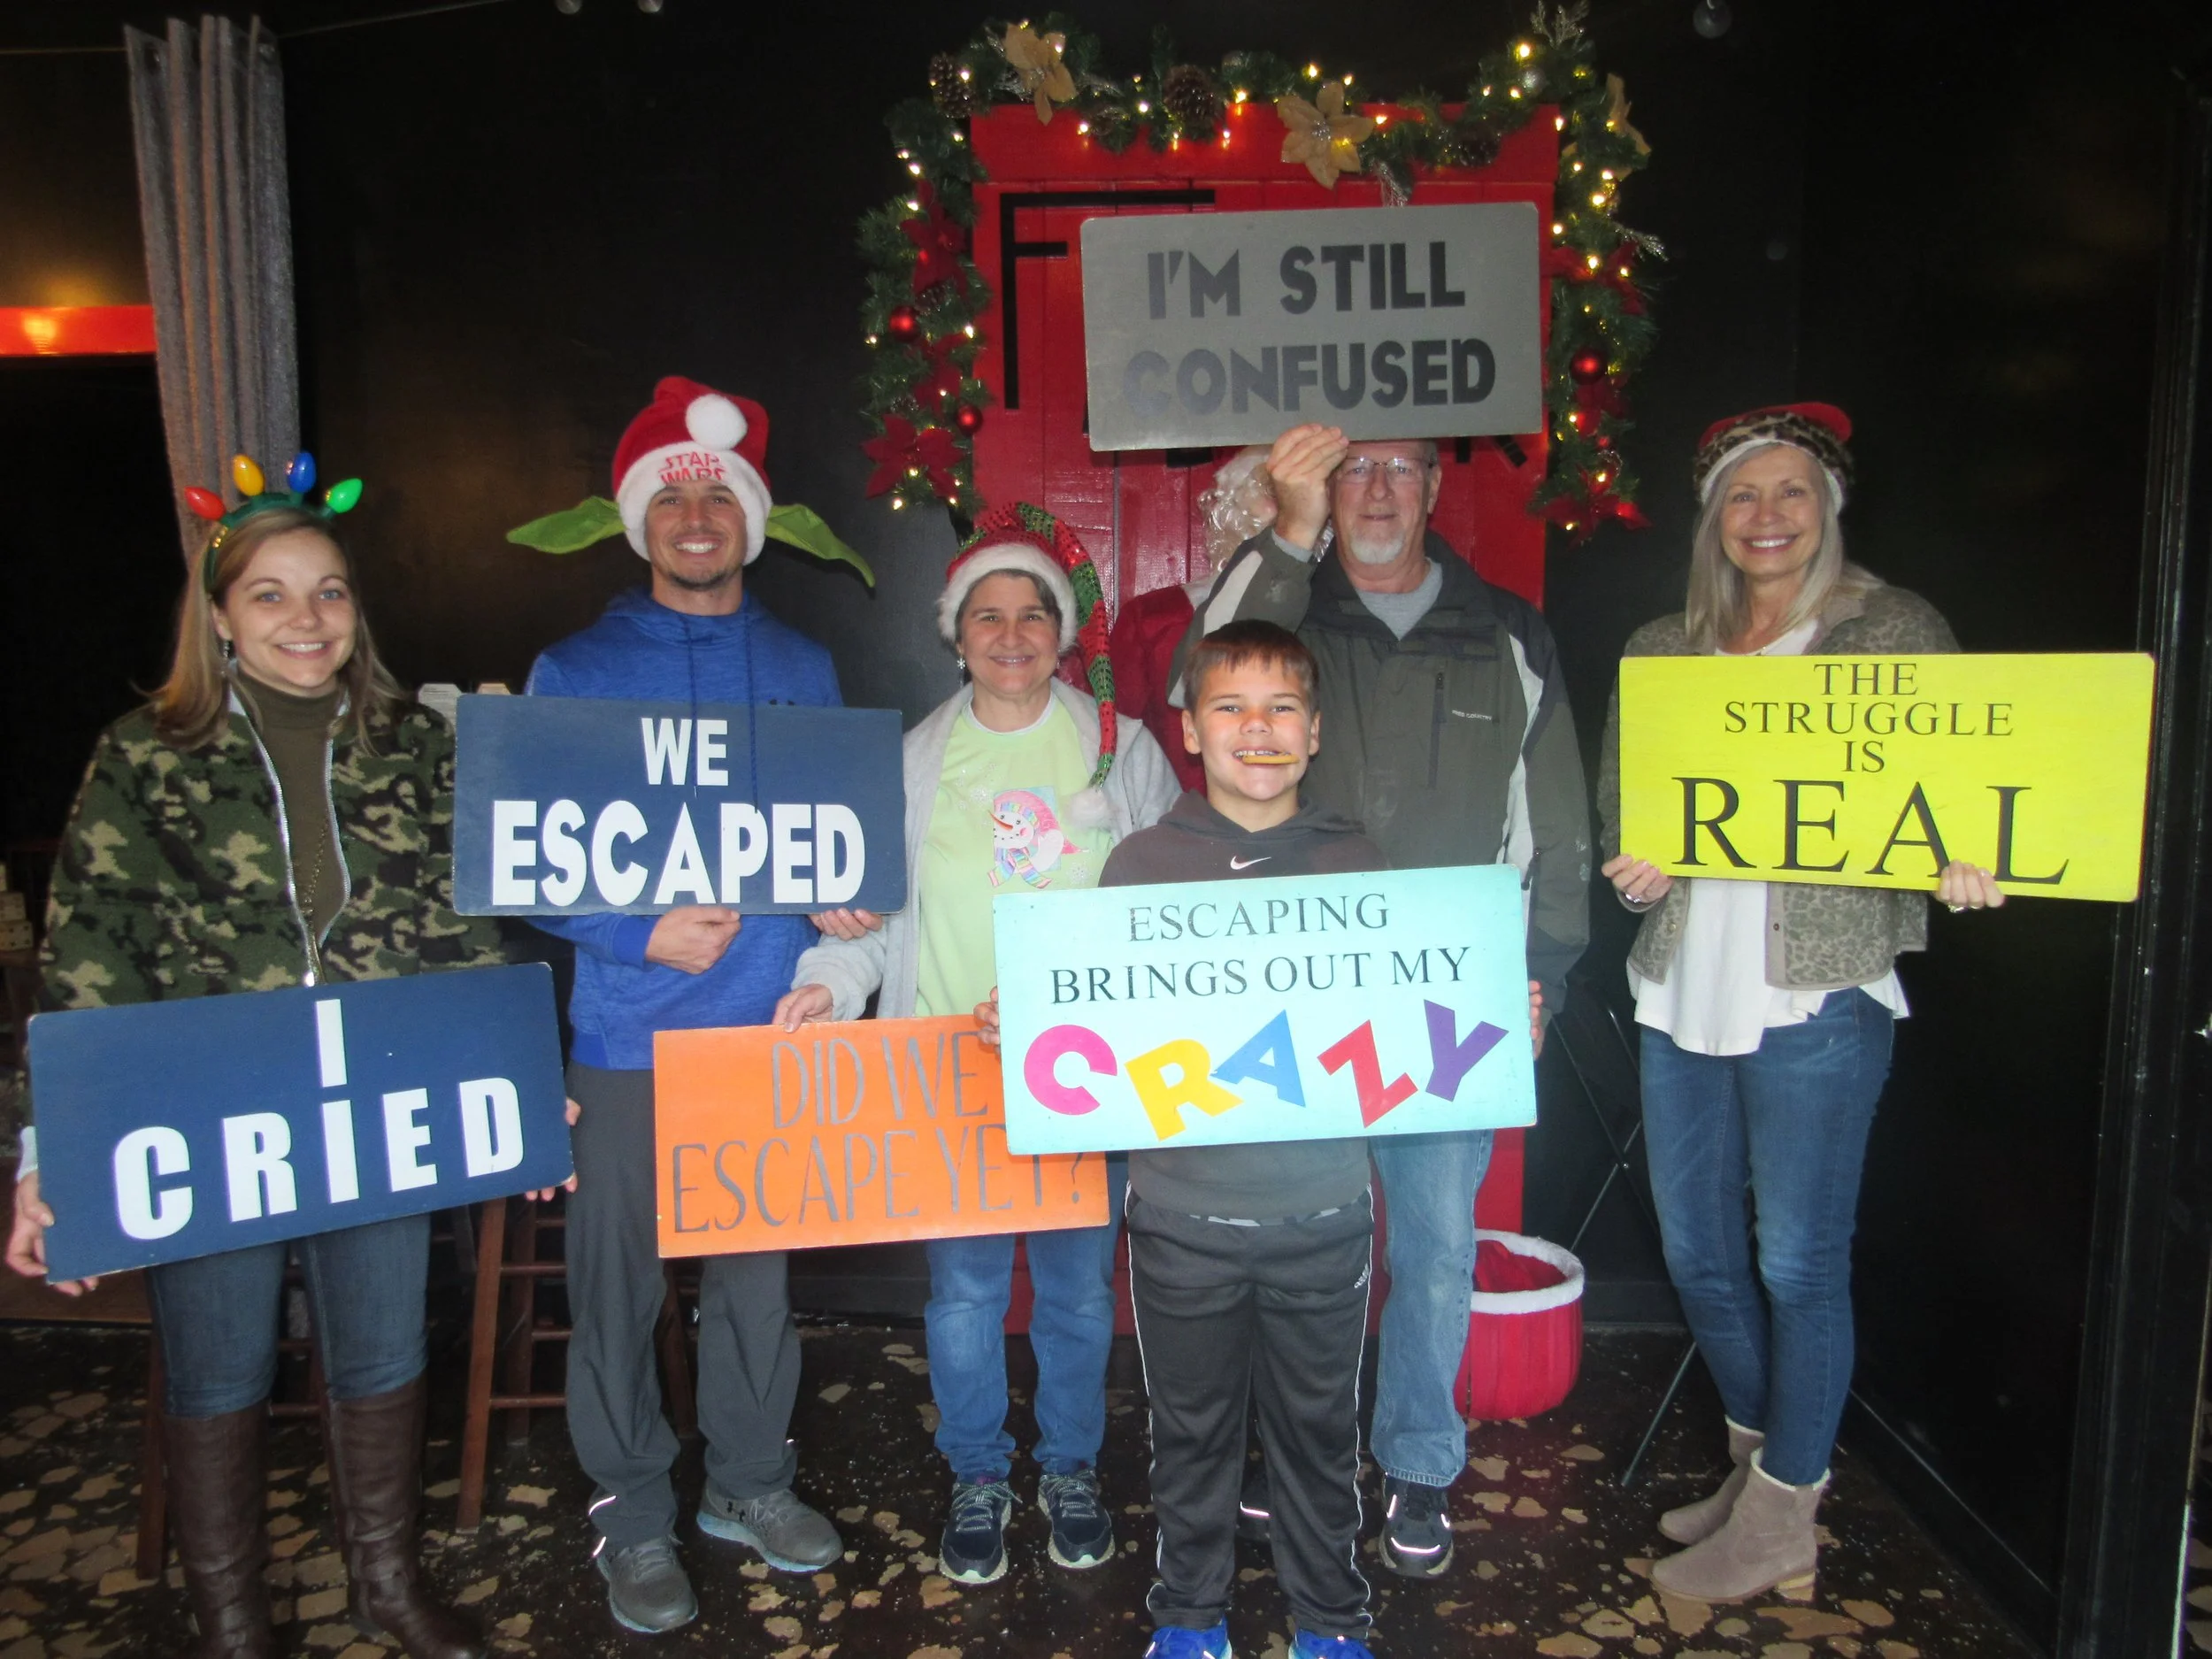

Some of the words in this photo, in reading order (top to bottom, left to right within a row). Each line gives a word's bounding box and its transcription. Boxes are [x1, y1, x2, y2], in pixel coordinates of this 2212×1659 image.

[1148, 249, 1240, 319] I'M
[1279, 242, 1465, 314] STILL
[1124, 338, 1495, 418] CONFUSED
[1814, 662, 1918, 696] THE
[641, 718, 728, 786] WE
[1724, 702, 2014, 737] STRUGGLE
[1844, 741, 1886, 773] IS
[492, 799, 865, 906] ESCAPED
[1671, 777, 2070, 886] REAL
[1128, 893, 1389, 942] ESCAPING
[1048, 959, 1247, 1005] BRINGS
[1264, 952, 1371, 993] OUT
[1391, 946, 1471, 985] MY
[315, 999, 347, 1087] I
[772, 1038, 864, 1129] DID
[881, 1031, 987, 1120] WE
[1024, 999, 1509, 1141] CRAZY
[112, 1077, 525, 1240] CRIED
[672, 1130, 919, 1233] ESCAPE
